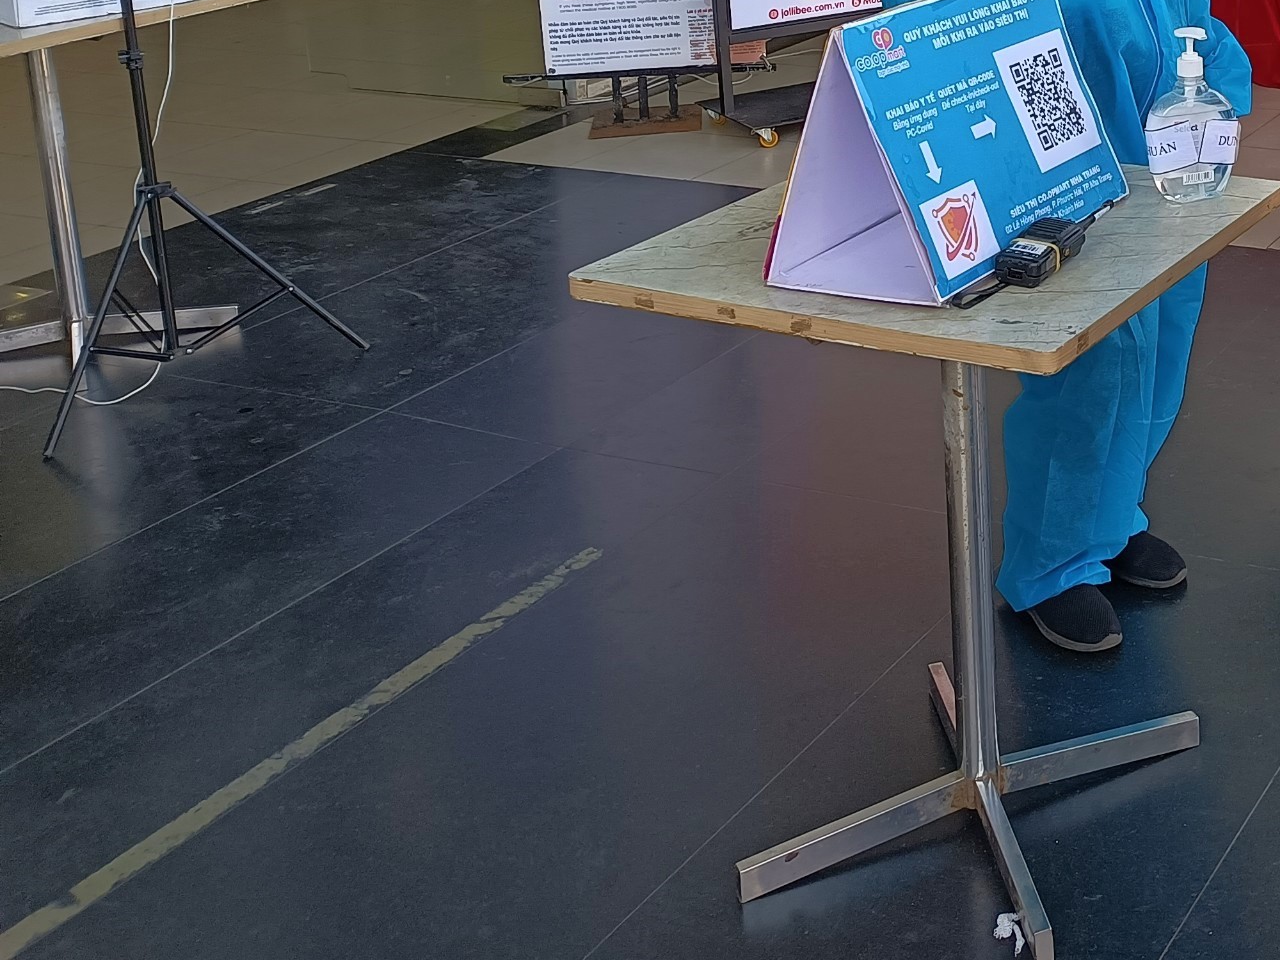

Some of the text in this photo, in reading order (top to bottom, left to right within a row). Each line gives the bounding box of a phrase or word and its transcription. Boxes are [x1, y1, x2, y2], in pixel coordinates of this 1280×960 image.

[781, 1, 845, 19] jollibee.com.vn
[903, 28, 922, 43] QUÝ
[922, 17, 953, 38] KHÁCH
[953, 15, 968, 29] VUI
[969, 7, 992, 25] LÒNG
[991, 1, 1011, 16] KHAI
[951, 33, 966, 45] KHI
[965, 29, 978, 41] RA
[977, 20, 996, 35] VÀO
[994, 11, 1014, 30] SIÊU
[1013, 7, 1030, 22] THỊ
[885, 106, 905, 121] KHAI
[904, 99, 920, 114] BÁO
[918, 98, 926, 107] Y
[1009, 202, 1026, 218] SIÊU
[1070, 174, 1084, 187] NHA
[1081, 164, 1101, 180] TRANG
